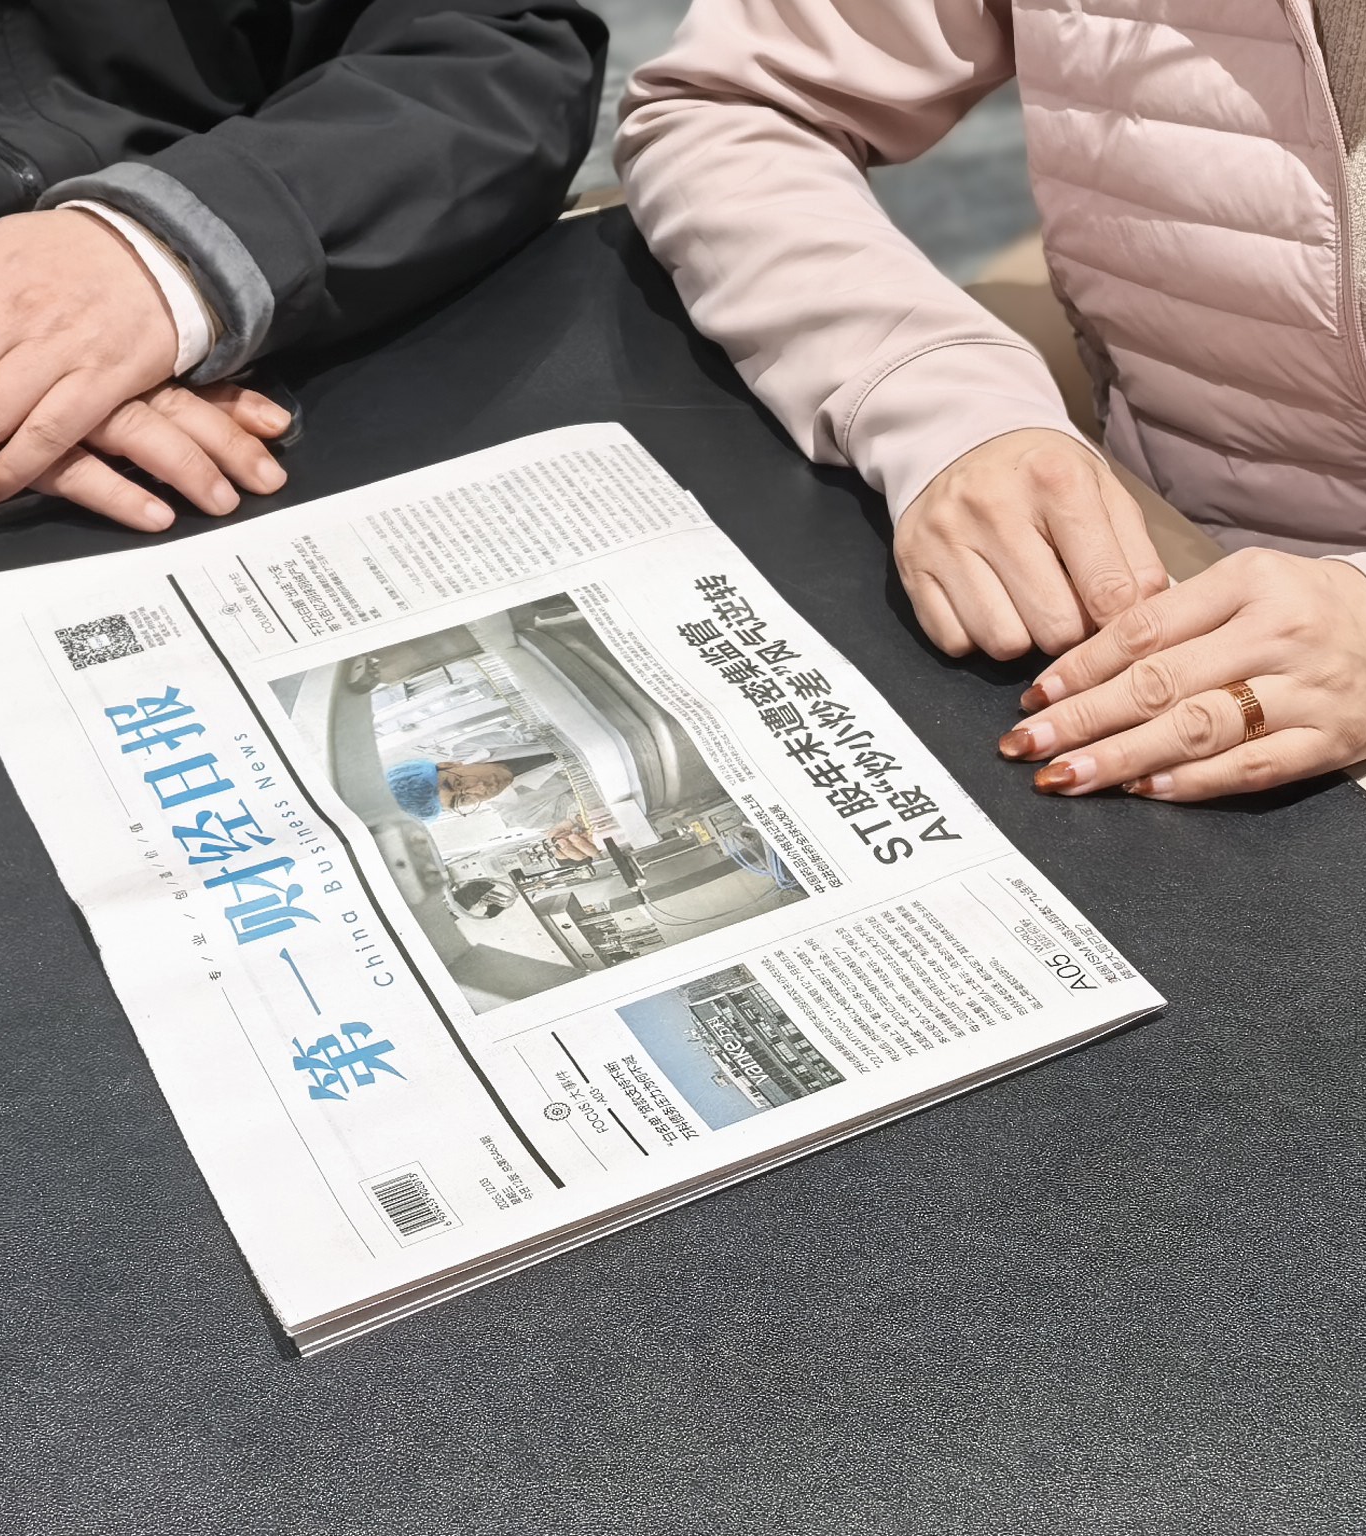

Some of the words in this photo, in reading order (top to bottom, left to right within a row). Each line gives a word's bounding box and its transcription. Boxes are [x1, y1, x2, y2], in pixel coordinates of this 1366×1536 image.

[234, 734, 276, 789] News
[274, 801, 343, 894] Business
[103, 686, 406, 1100] 第一财经日报
[341, 911, 394, 987] China
[1042, 951, 1098, 996] A05
